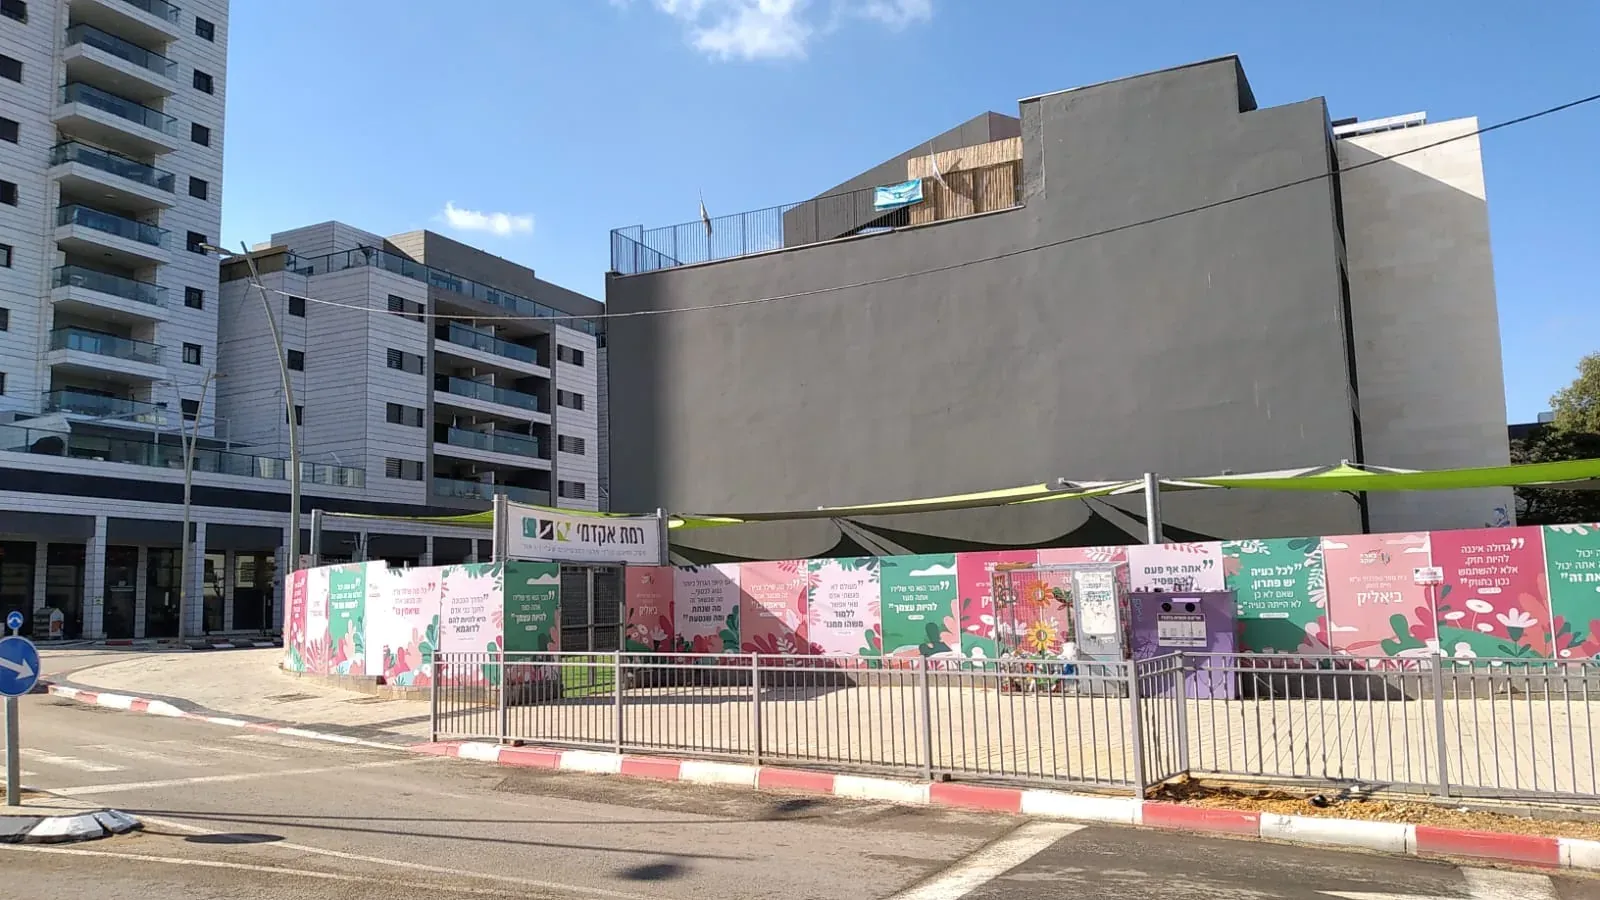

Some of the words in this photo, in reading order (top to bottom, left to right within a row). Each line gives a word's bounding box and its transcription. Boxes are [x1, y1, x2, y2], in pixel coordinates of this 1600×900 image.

[576, 523, 617, 546] אקדמי
[620, 525, 645, 544] רמת
[1461, 545, 1484, 554] איננה
[1576, 549, 1593, 558] יכול
[1486, 554, 1510, 564] להיות
[1555, 561, 1572, 570] יכול
[1575, 561, 1595, 569] אתה
[1144, 566, 1164, 574] פעם
[1166, 565, 1179, 575] אף
[1250, 567, 1274, 577] בעיה
[1458, 566, 1498, 576] להשתמש
[1500, 565, 1518, 575] אלא
[1283, 579, 1296, 587] יש
[1495, 577, 1510, 588] נכון
[1254, 591, 1262, 600] כן
[1263, 590, 1274, 598] לא
[1356, 590, 1403, 606] ביאליק
[916, 602, 938, 611] להיות
[1290, 600, 1302, 608] לא
[833, 609, 855, 618] ללמוד
[844, 620, 864, 628] משהו
